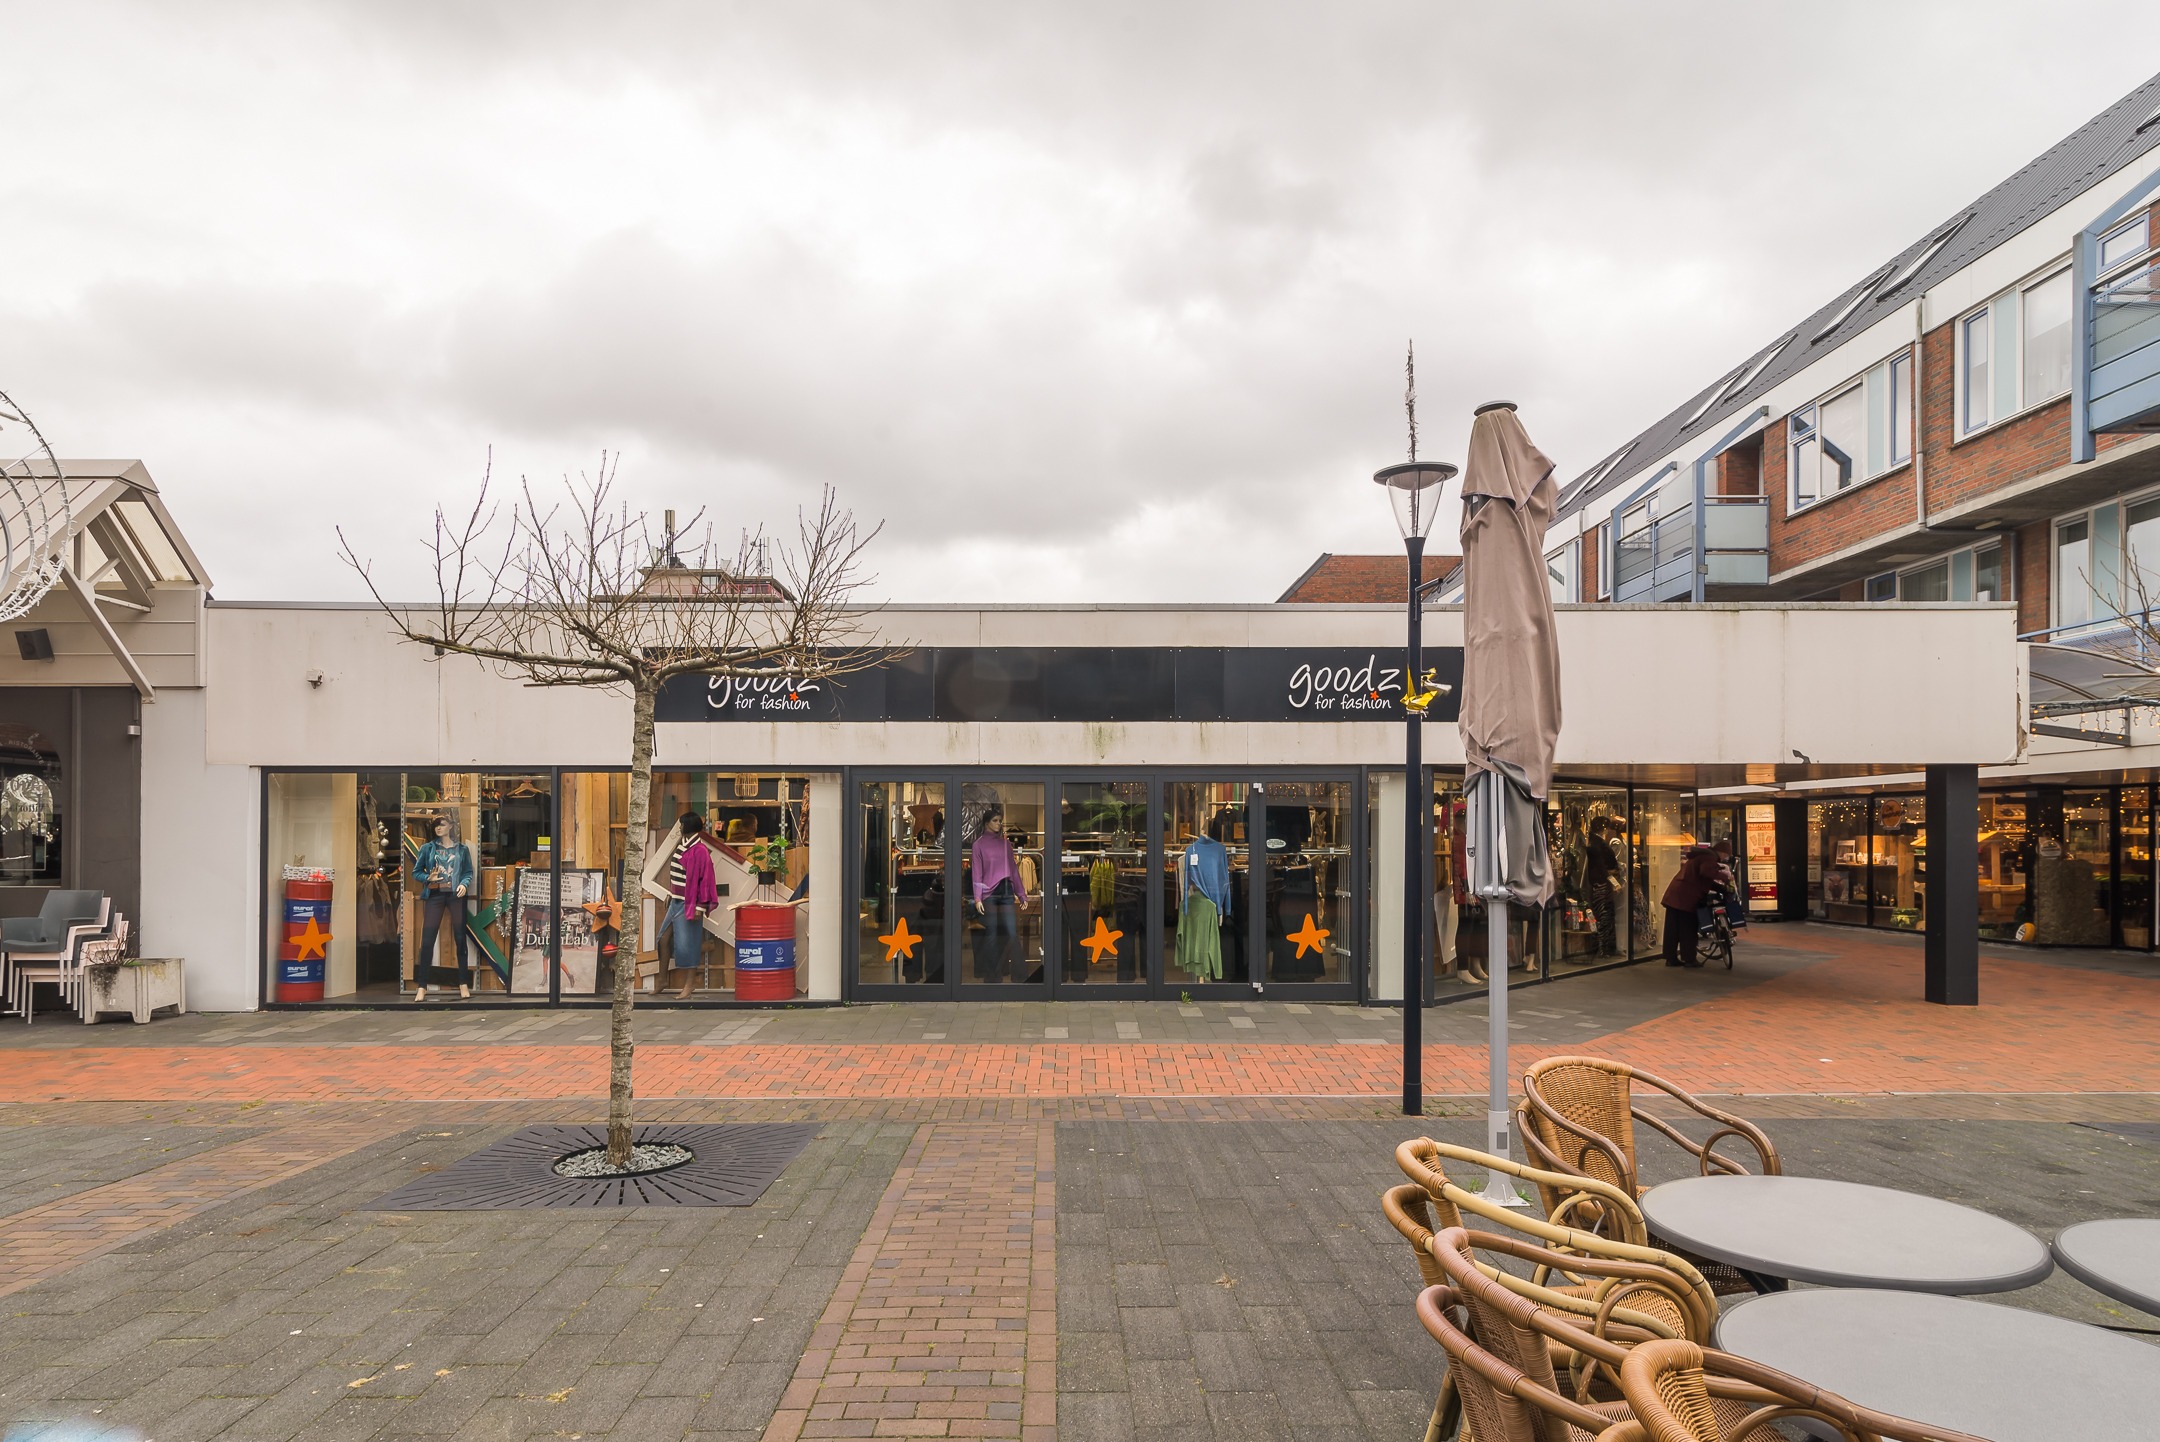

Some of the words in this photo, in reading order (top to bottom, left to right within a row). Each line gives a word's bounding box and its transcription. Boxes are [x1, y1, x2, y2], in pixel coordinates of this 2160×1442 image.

[1288, 654, 1402, 708] goodz
[734, 693, 756, 710] for
[759, 691, 811, 710] fashion
[1314, 693, 1336, 710] for
[1340, 690, 1392, 710] fashion
[526, 932, 588, 945] DutLab
